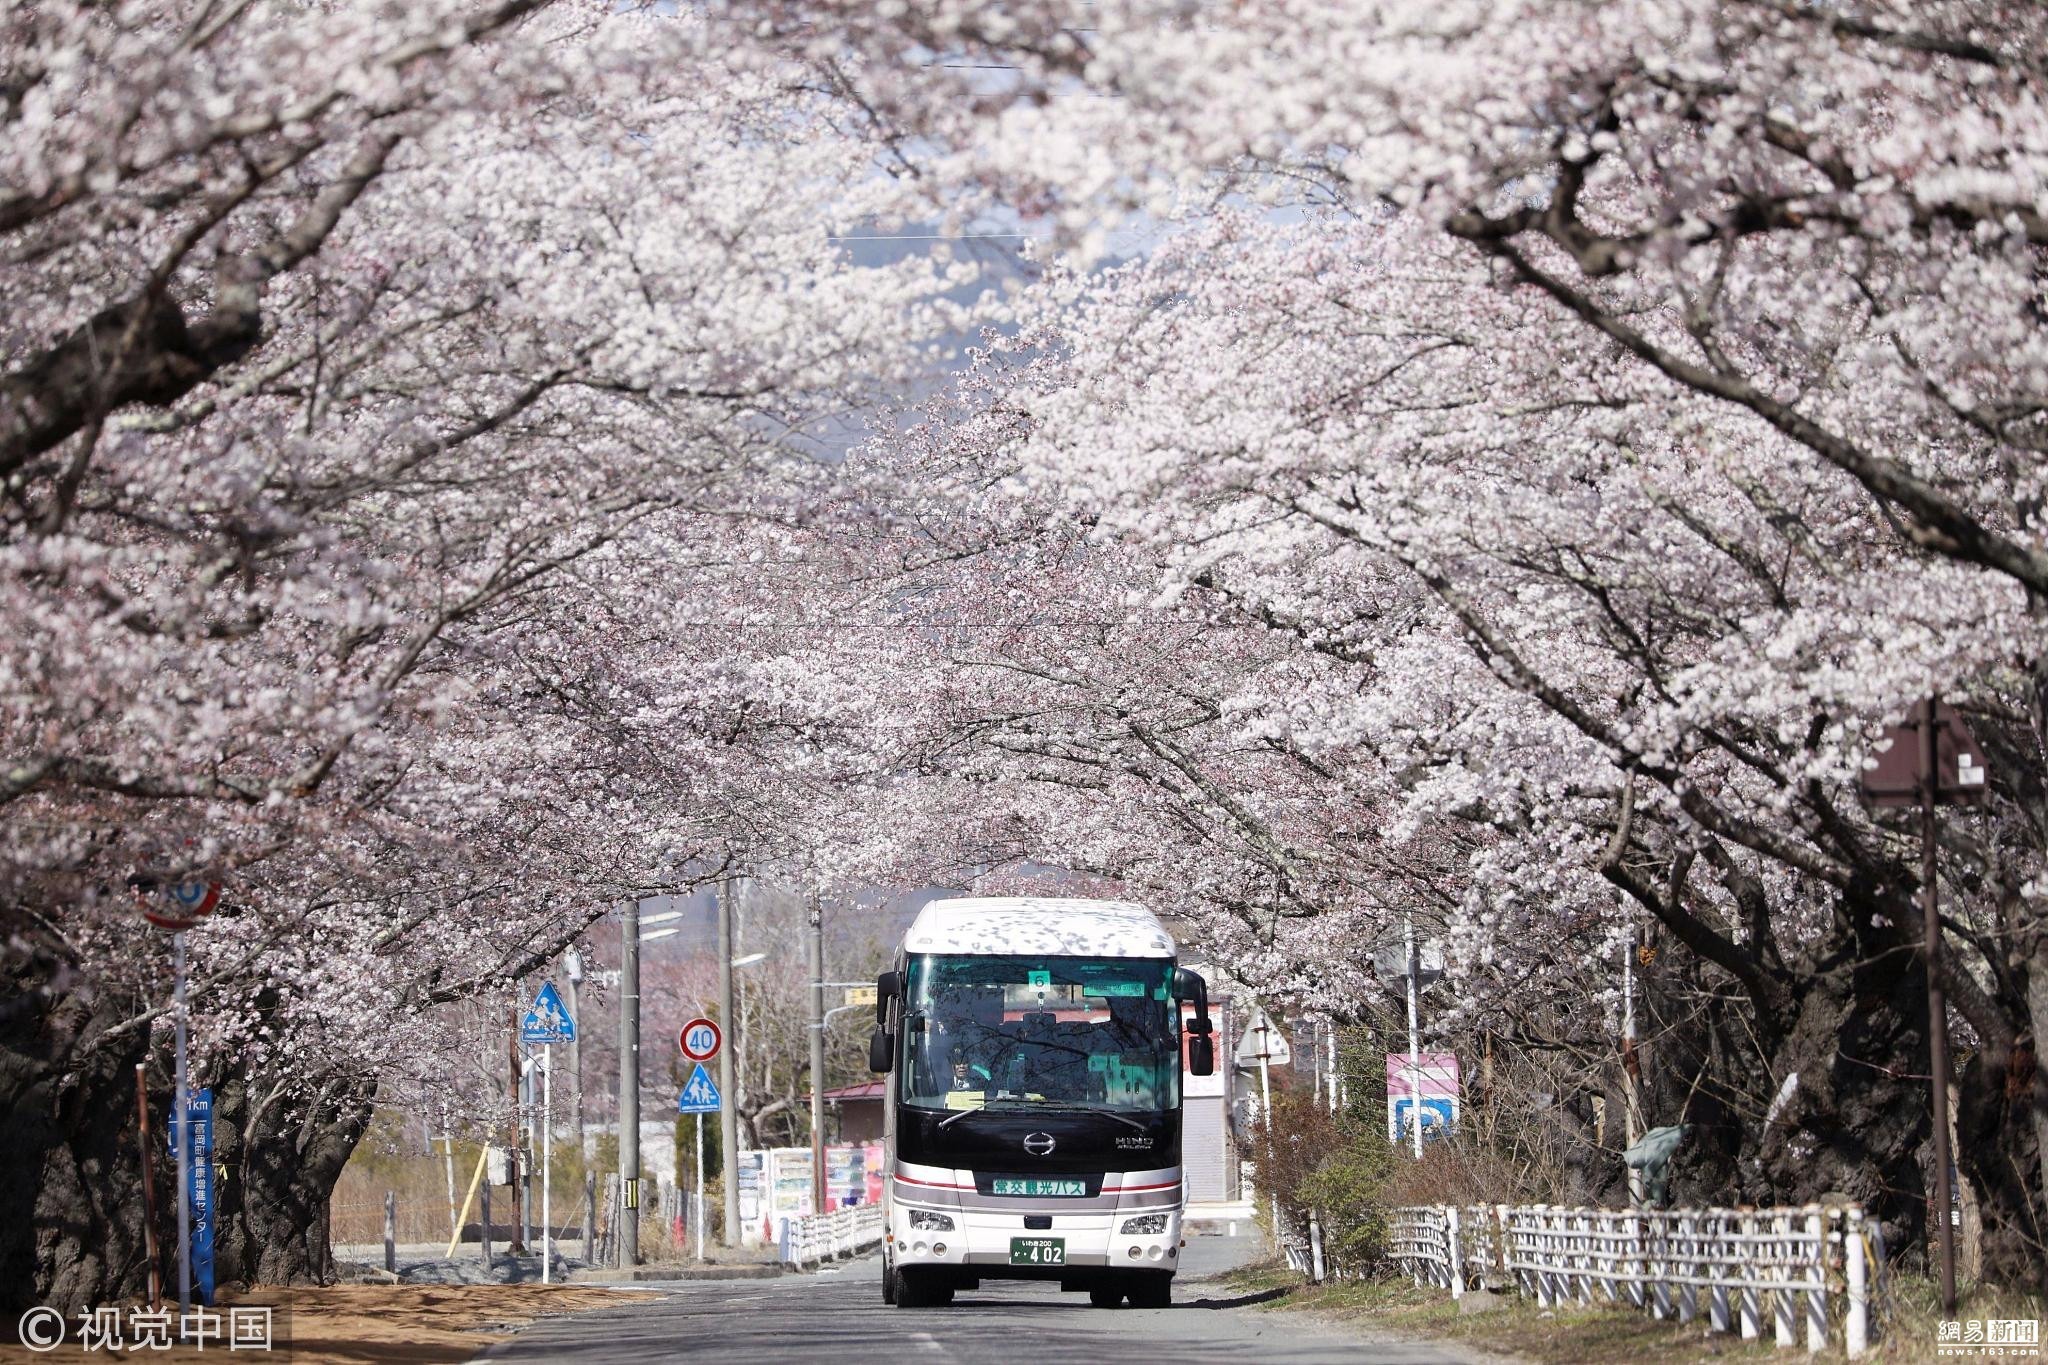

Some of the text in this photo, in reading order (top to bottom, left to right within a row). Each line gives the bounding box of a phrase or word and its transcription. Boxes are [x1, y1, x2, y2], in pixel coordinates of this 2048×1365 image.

[1035, 976, 1044, 987] 6
[689, 1030, 712, 1050] 40
[1115, 1137, 1153, 1145] HINO
[995, 1179, 1083, 1195] 常交観光バス
